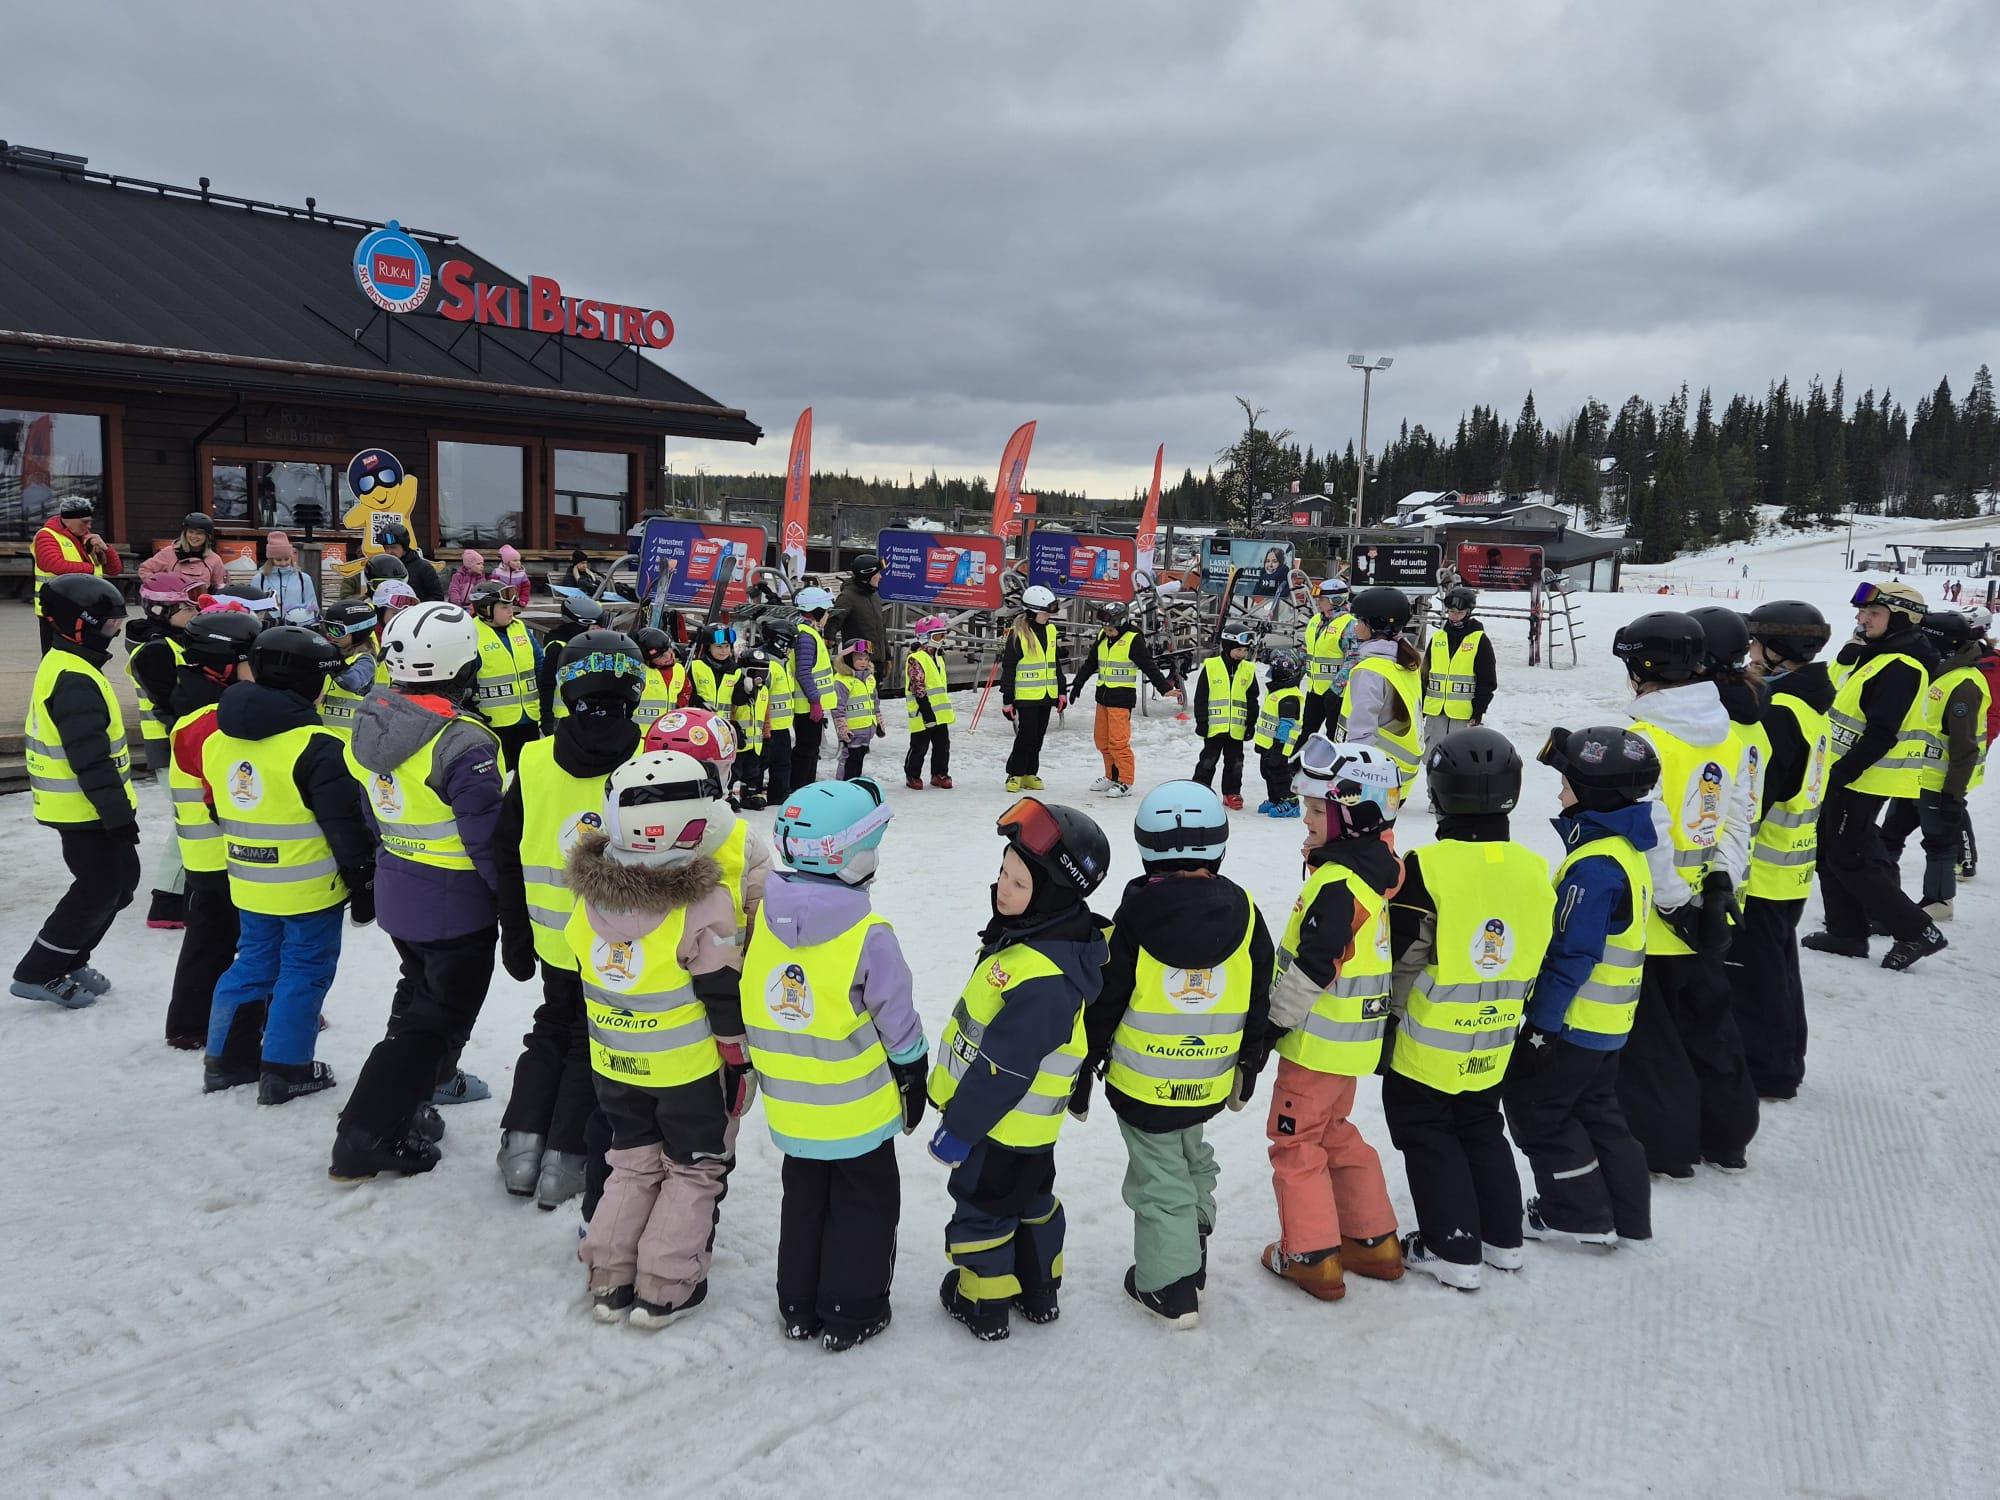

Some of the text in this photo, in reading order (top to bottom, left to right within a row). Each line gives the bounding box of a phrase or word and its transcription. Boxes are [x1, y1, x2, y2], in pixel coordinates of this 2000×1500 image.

[359, 266, 431, 312] SKI BISTRO VUOSSELI
[437, 260, 675, 349] SKI BISTRO
[695, 544, 718, 554] Rennie
[892, 546, 919, 554] Varusteet
[932, 552, 956, 561] Rennie
[1390, 558, 1408, 566] Kohti
[319, 660, 341, 669] SMITH
[1351, 768, 1388, 783] SMITH
[1059, 853, 1090, 889] SMITH
[592, 1014, 658, 1029] UKOKIITO
[1454, 1013, 1516, 1027] KAUKOKIITO
[1146, 1044, 1229, 1058] KAUKOKIITO
